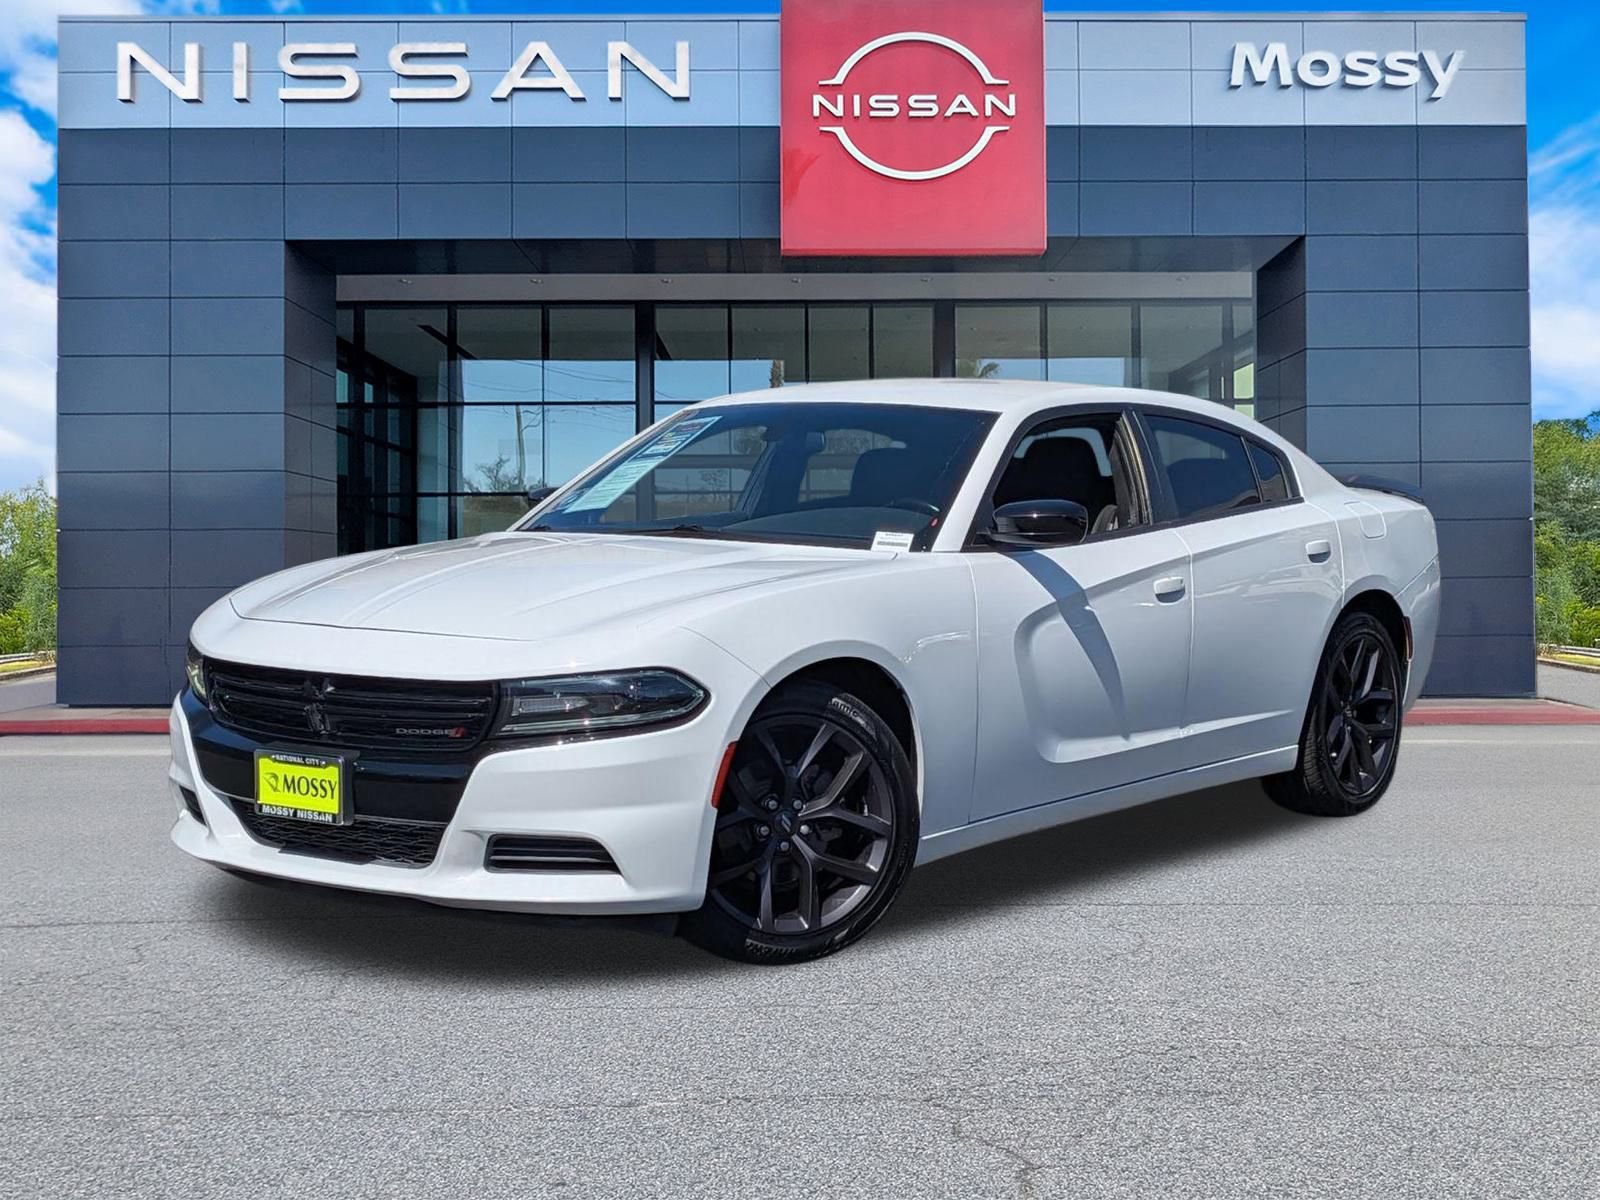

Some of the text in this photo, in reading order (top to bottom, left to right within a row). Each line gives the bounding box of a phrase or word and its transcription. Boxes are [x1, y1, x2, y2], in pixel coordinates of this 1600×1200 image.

[117, 41, 691, 102] NISSAN
[1229, 41, 1465, 101] Mossy
[812, 92, 1017, 118] NISSAN
[305, 757, 319, 766] CITY
[282, 774, 337, 800] MOSSY
[262, 804, 333, 822] MOSSY NISSAN
